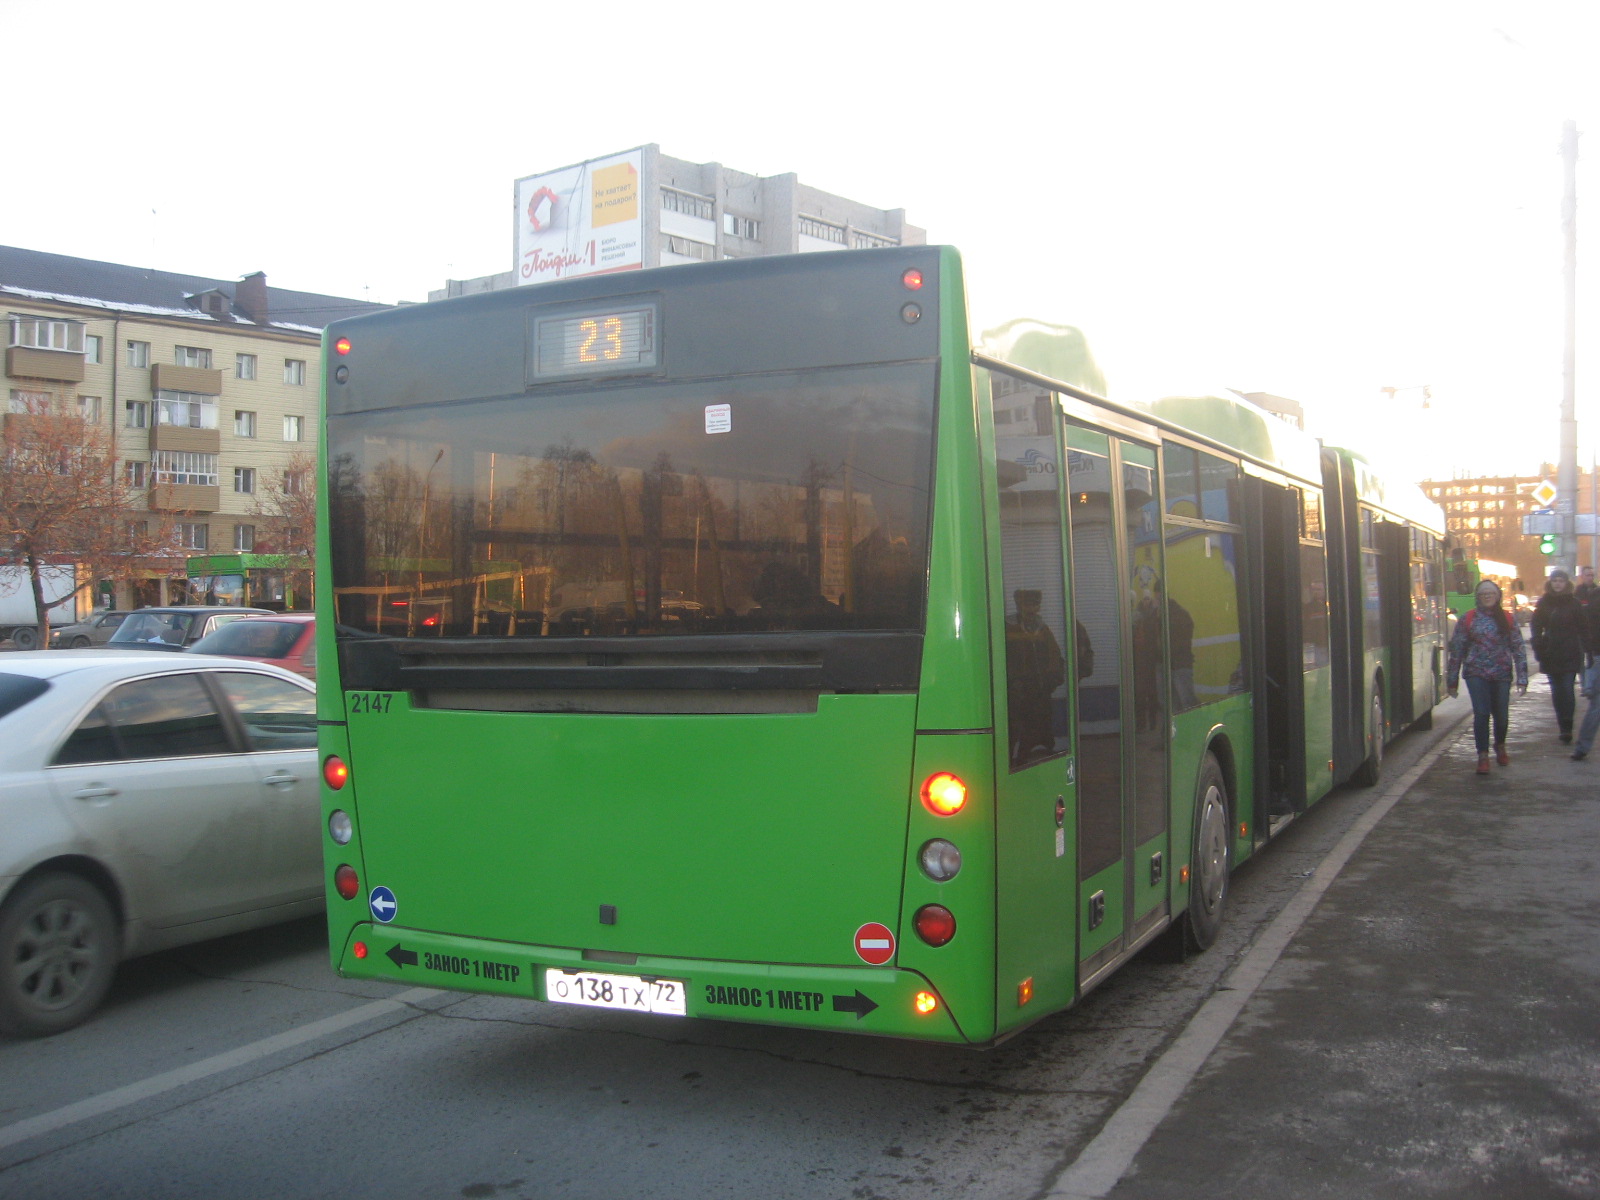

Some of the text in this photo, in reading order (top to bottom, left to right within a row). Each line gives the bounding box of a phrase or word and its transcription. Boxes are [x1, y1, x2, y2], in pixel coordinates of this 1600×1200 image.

[595, 183, 632, 198] Не хватает
[604, 192, 637, 207] подарок?
[601, 237, 617, 246] БЮРО
[601, 241, 637, 254] ФИНАНСОВЫХ
[521, 240, 590, 279] Пойдём!
[601, 251, 626, 262] РЕШЕНИЙ
[579, 317, 621, 362] 23
[351, 693, 393, 714] 2147
[424, 952, 520, 982] ЗАНОС 1 МЕТР
[705, 984, 824, 1012] ЗАНОС 1 МЕТР
